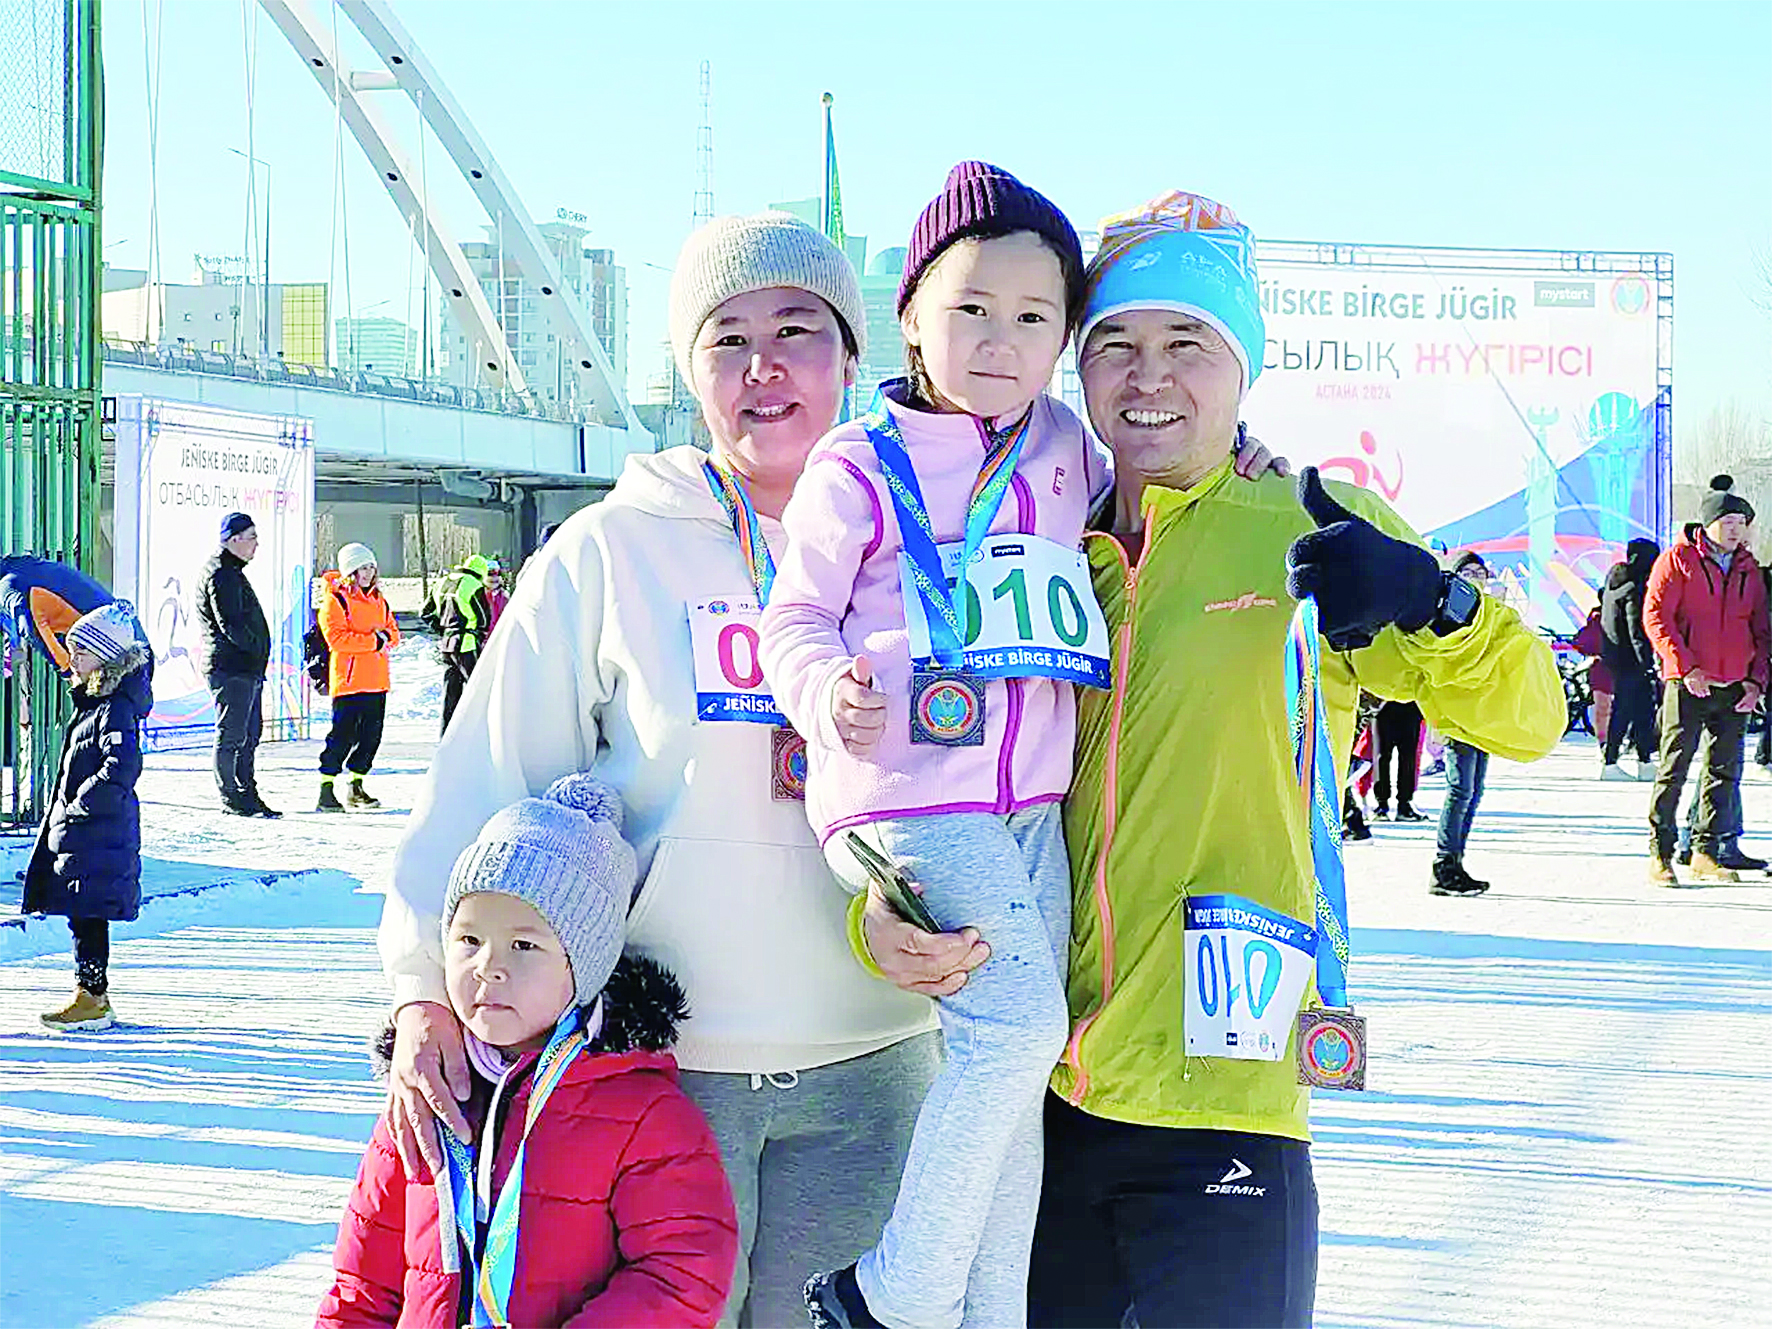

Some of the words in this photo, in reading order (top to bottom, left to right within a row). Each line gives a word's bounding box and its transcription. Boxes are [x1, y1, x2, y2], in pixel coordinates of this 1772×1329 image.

[1435, 286, 1517, 321] JÜGİR
[1539, 287, 1590, 303] mystart
[1363, 384, 1391, 400] 2024
[723, 694, 778, 714] JEÑİSK
[1197, 933, 1283, 1020] 010
[1204, 1184, 1267, 1197] DEMIX
